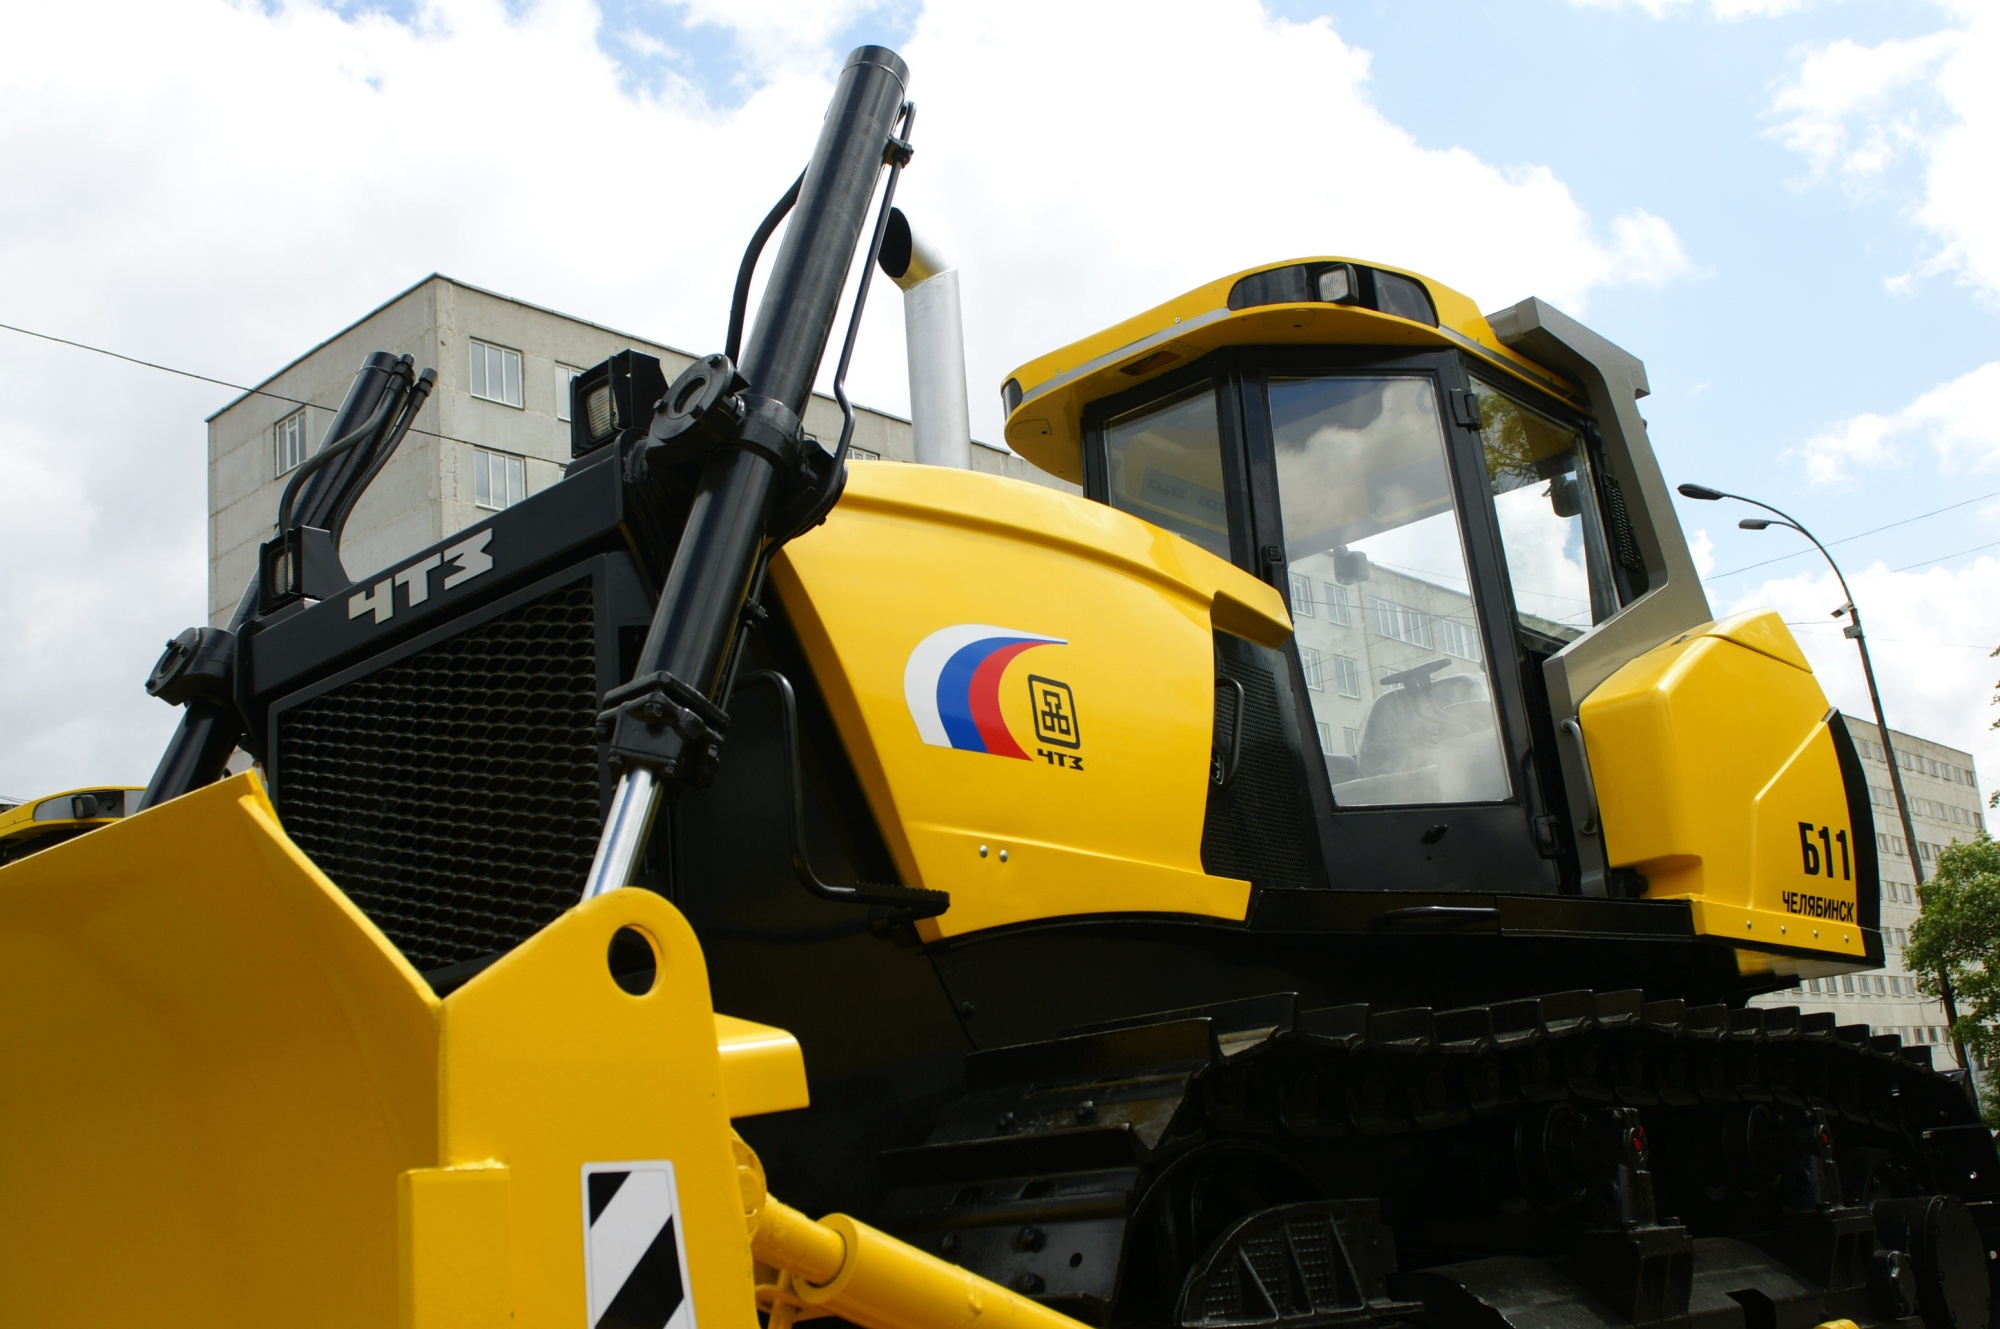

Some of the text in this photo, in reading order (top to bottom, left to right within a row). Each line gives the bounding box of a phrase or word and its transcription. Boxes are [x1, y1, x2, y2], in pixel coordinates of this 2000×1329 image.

[348, 527, 494, 624] ЧТЗ
[1037, 748, 1084, 771] ЧТЗ
[1797, 821, 1851, 881] Б11
[1782, 890, 1854, 922] ЧЕЛЯБИНСК
